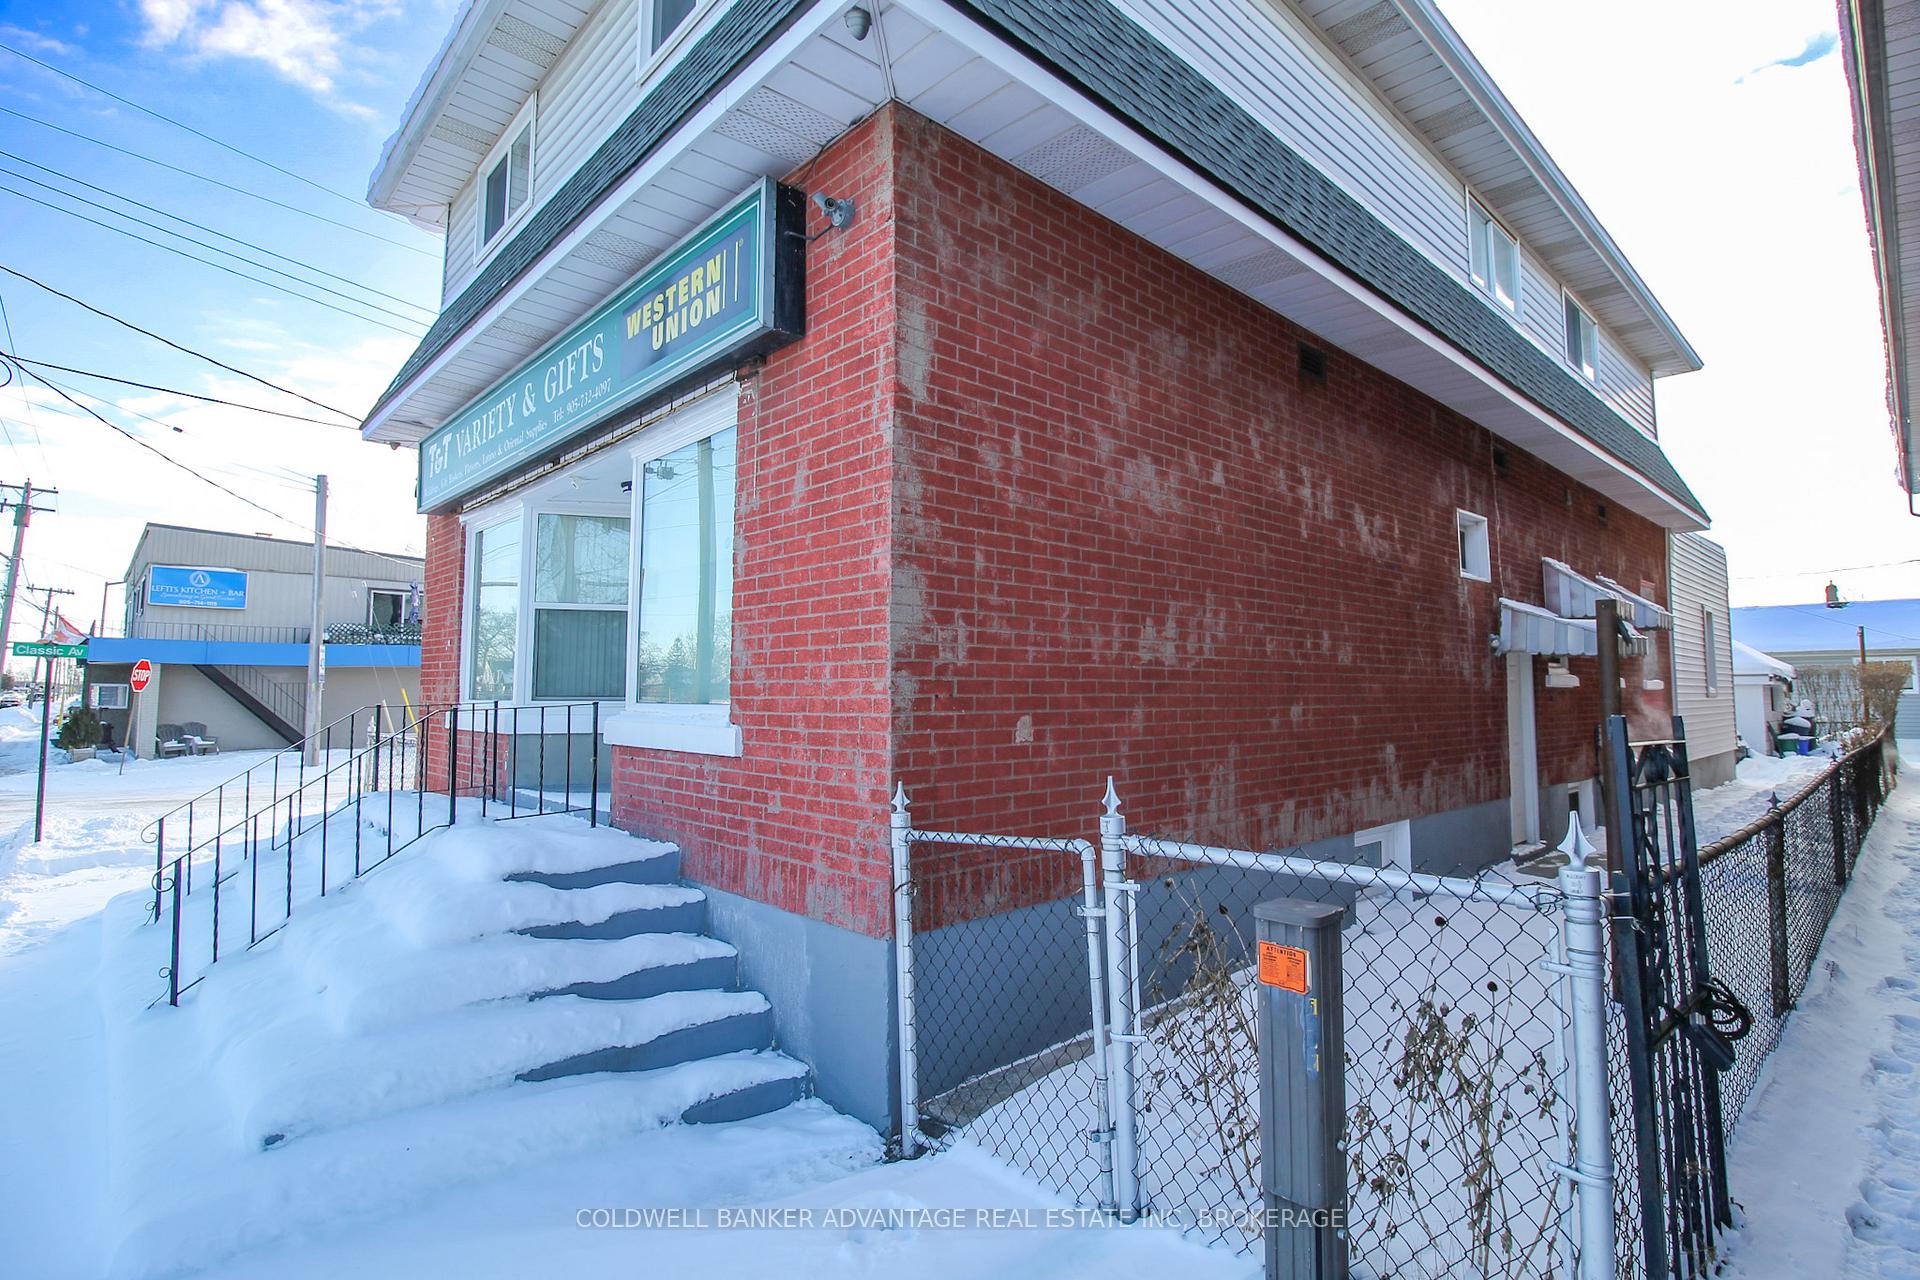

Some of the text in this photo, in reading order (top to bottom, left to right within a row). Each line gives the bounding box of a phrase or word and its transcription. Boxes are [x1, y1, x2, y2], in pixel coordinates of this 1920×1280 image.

[626, 253, 721, 339] WESTERN
[652, 284, 721, 351] UNION
[455, 392, 518, 457] VARIETY
[522, 382, 537, 417] &
[544, 332, 604, 403] GIFTS
[180, 587, 218, 596] KITCHEN
[228, 589, 245, 597] BAR
[16, 645, 84, 656] Classic Av
[133, 669, 150, 682] STOP
